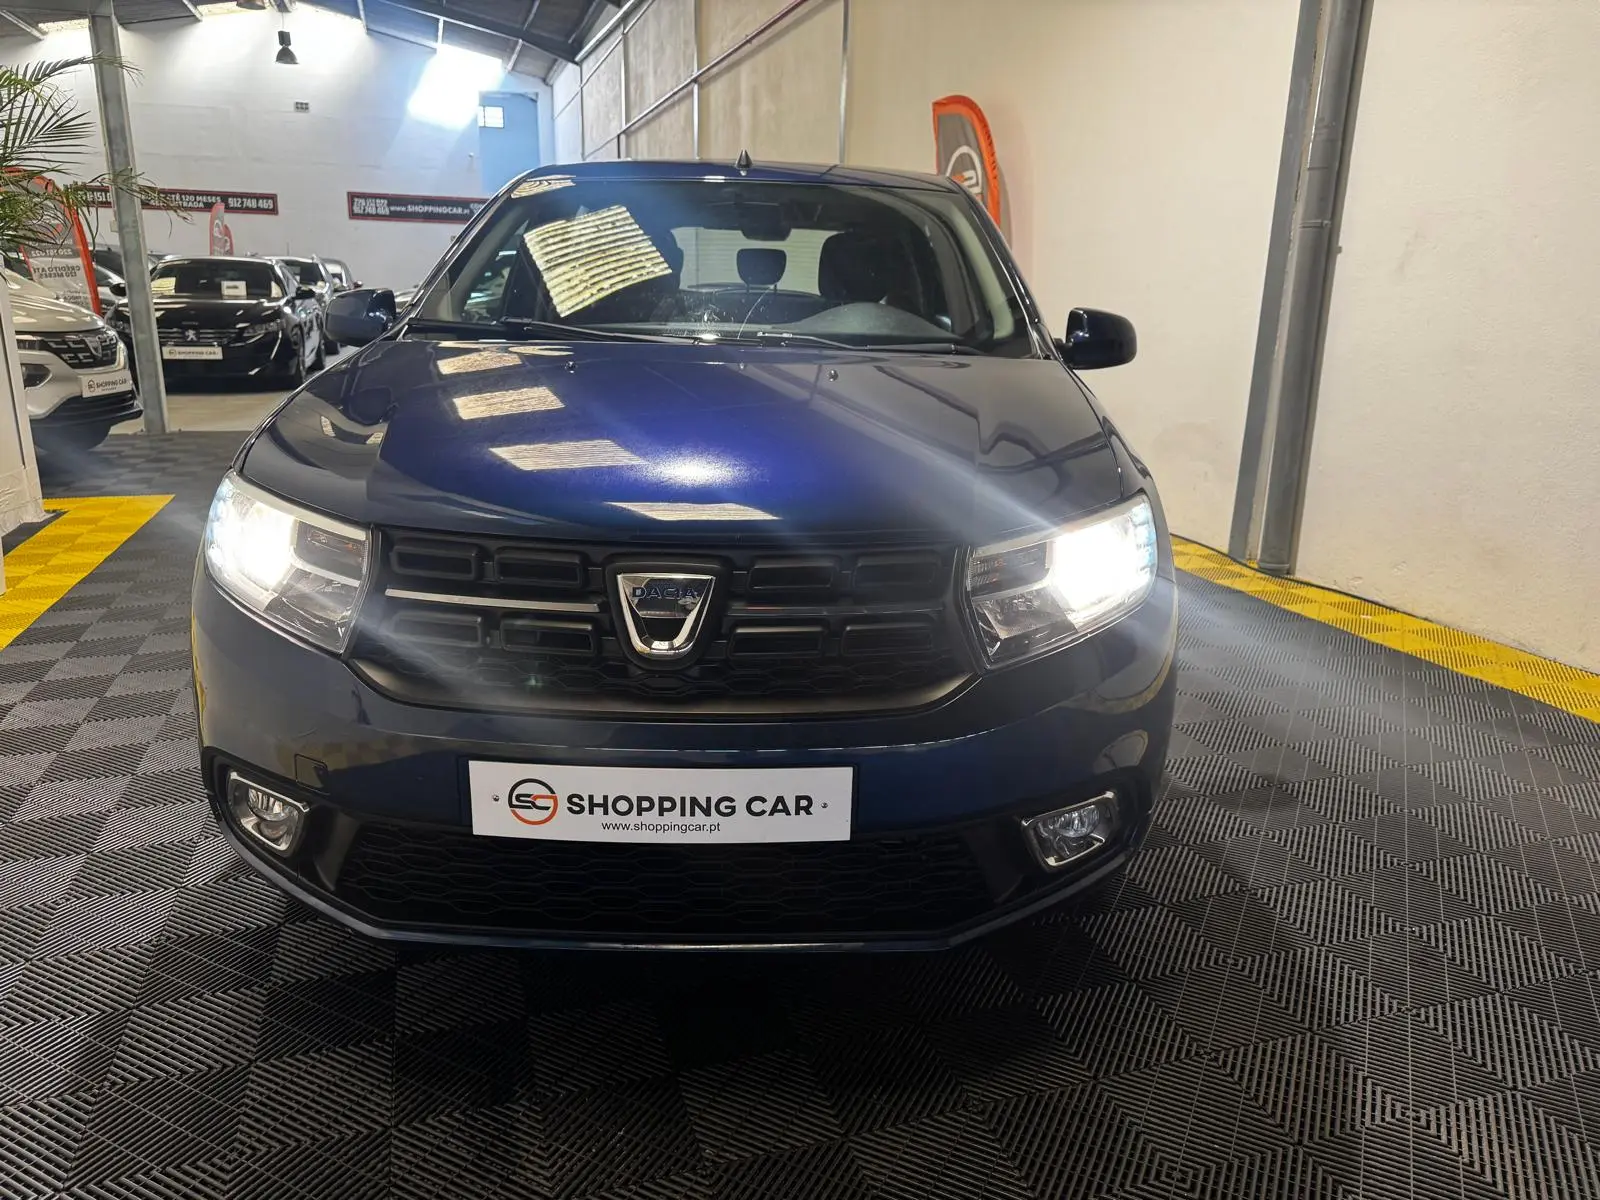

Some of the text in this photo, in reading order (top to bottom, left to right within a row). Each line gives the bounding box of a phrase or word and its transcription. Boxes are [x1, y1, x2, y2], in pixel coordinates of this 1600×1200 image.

[227, 197, 242, 208] 912
[258, 199, 273, 210] 469
[632, 586, 699, 599] DACIA
[566, 793, 736, 818] SHOPPING
[745, 795, 814, 817] CAR
[601, 821, 721, 834] www.shoppingcar.pt
